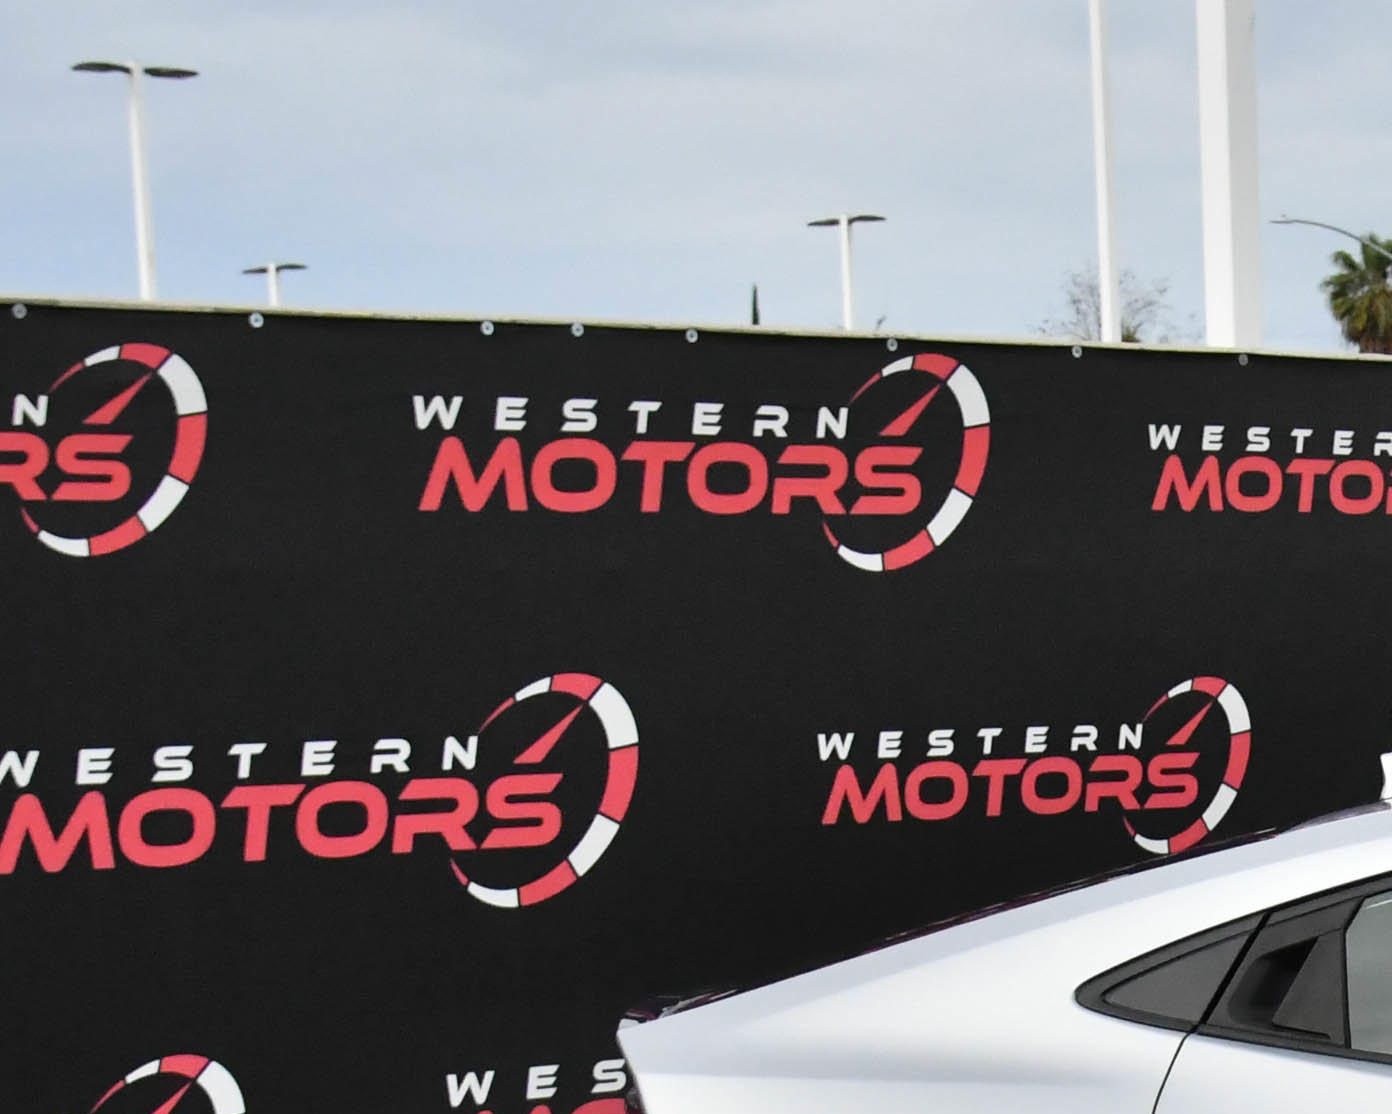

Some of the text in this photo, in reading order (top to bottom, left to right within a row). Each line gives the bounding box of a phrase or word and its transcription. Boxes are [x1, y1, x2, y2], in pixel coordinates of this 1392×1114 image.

[413, 395, 849, 439] WESTERN
[419, 436, 923, 515] MOTORS
[0, 735, 479, 788] WESTERN
[817, 723, 1143, 761] WESTERN
[822, 751, 1200, 825] MOTORS
[0, 772, 563, 875] MOTORS
